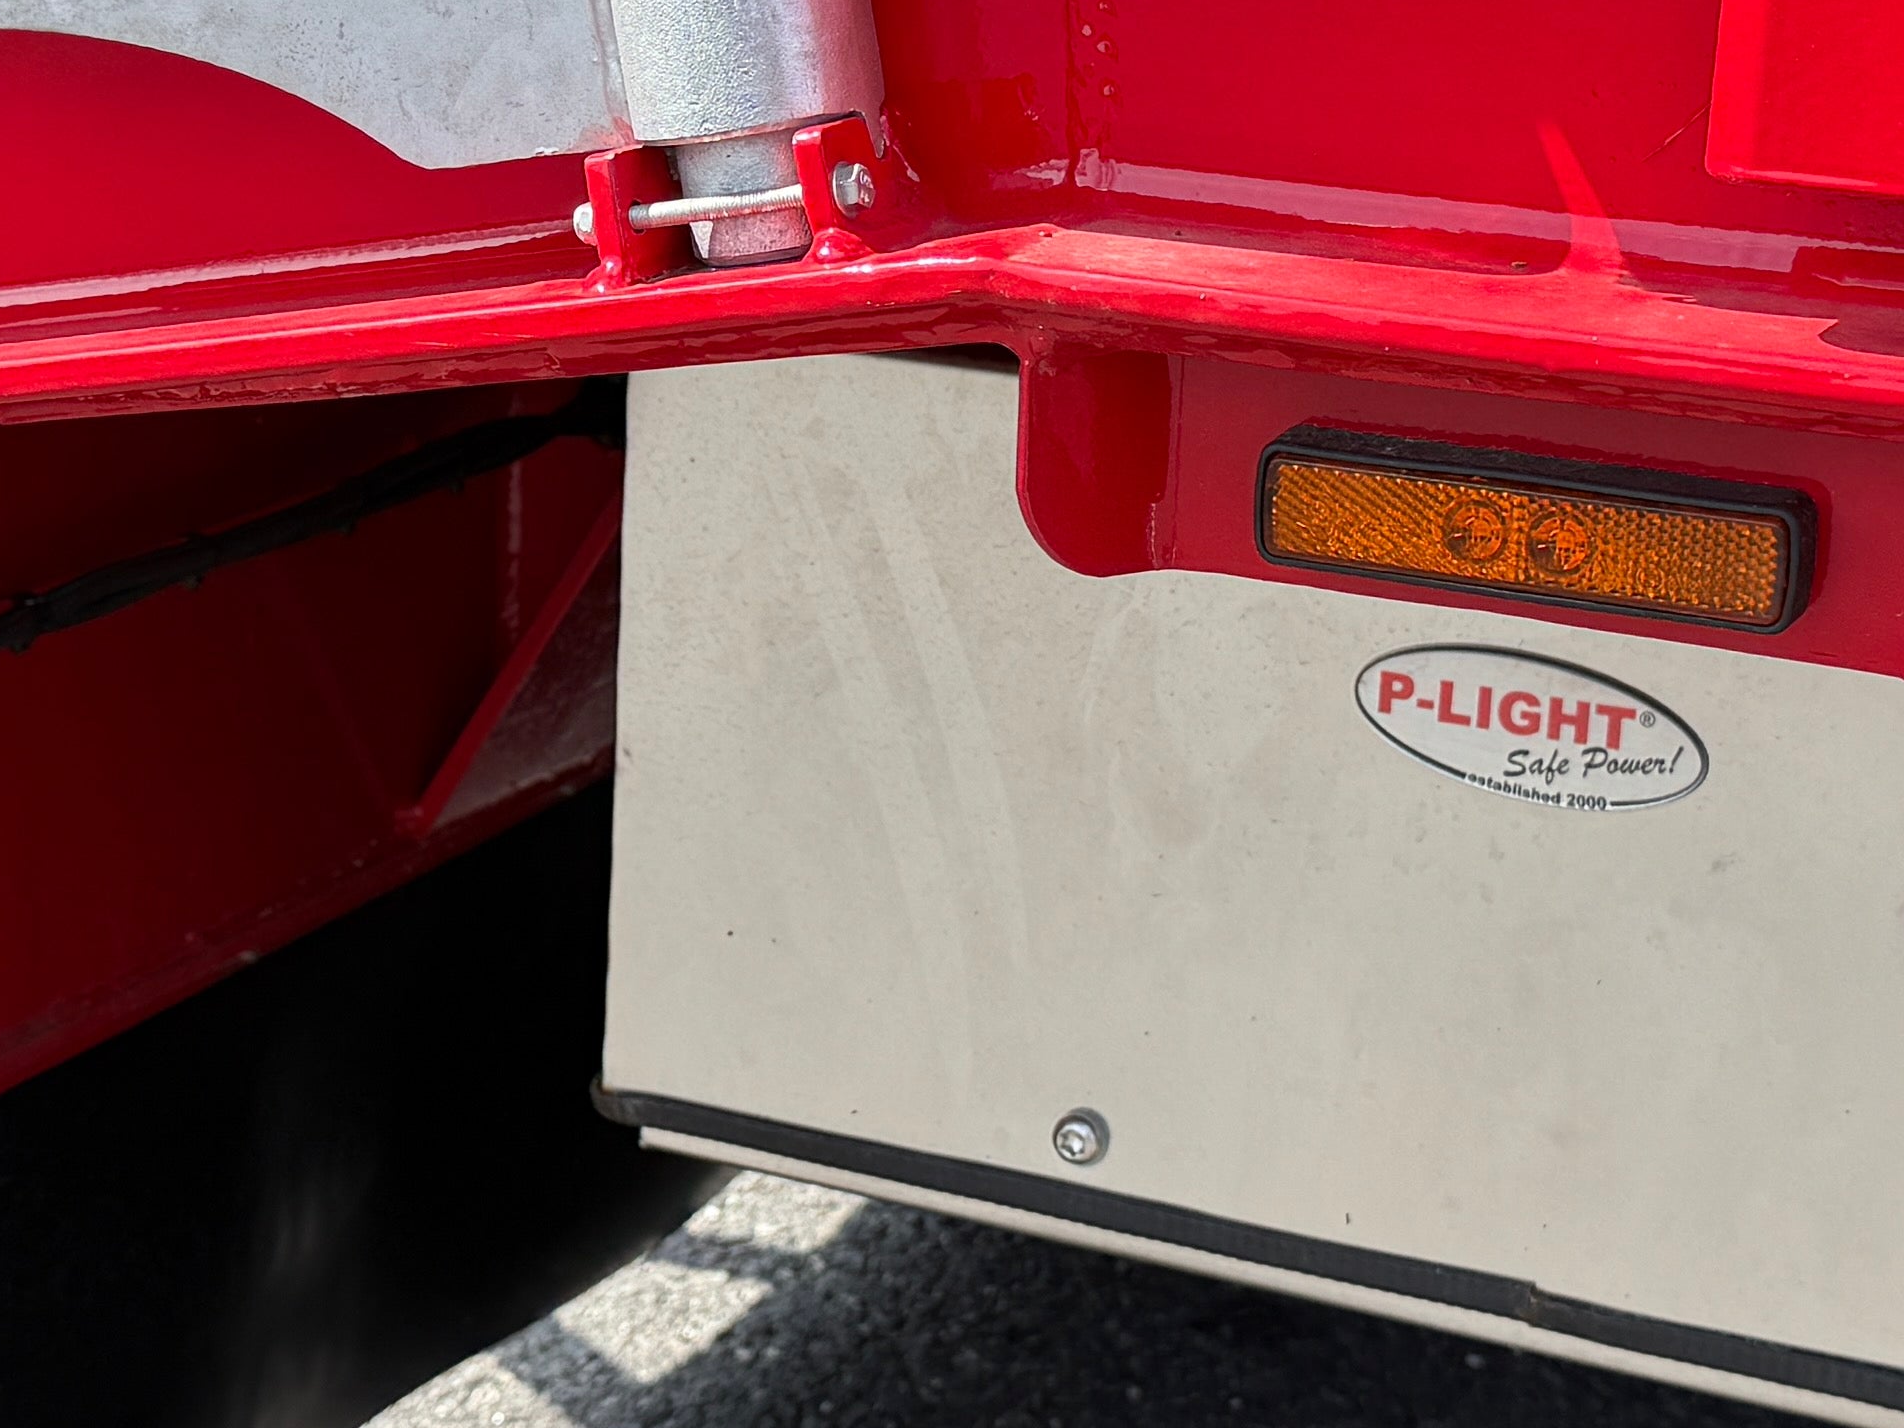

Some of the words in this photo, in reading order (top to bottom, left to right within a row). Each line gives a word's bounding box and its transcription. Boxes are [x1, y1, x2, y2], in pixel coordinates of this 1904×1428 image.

[1503, 747, 1571, 785] Safe
[1581, 745, 1684, 778] Power!
[1466, 772, 1562, 806] established
[1566, 791, 1608, 811] 2000
